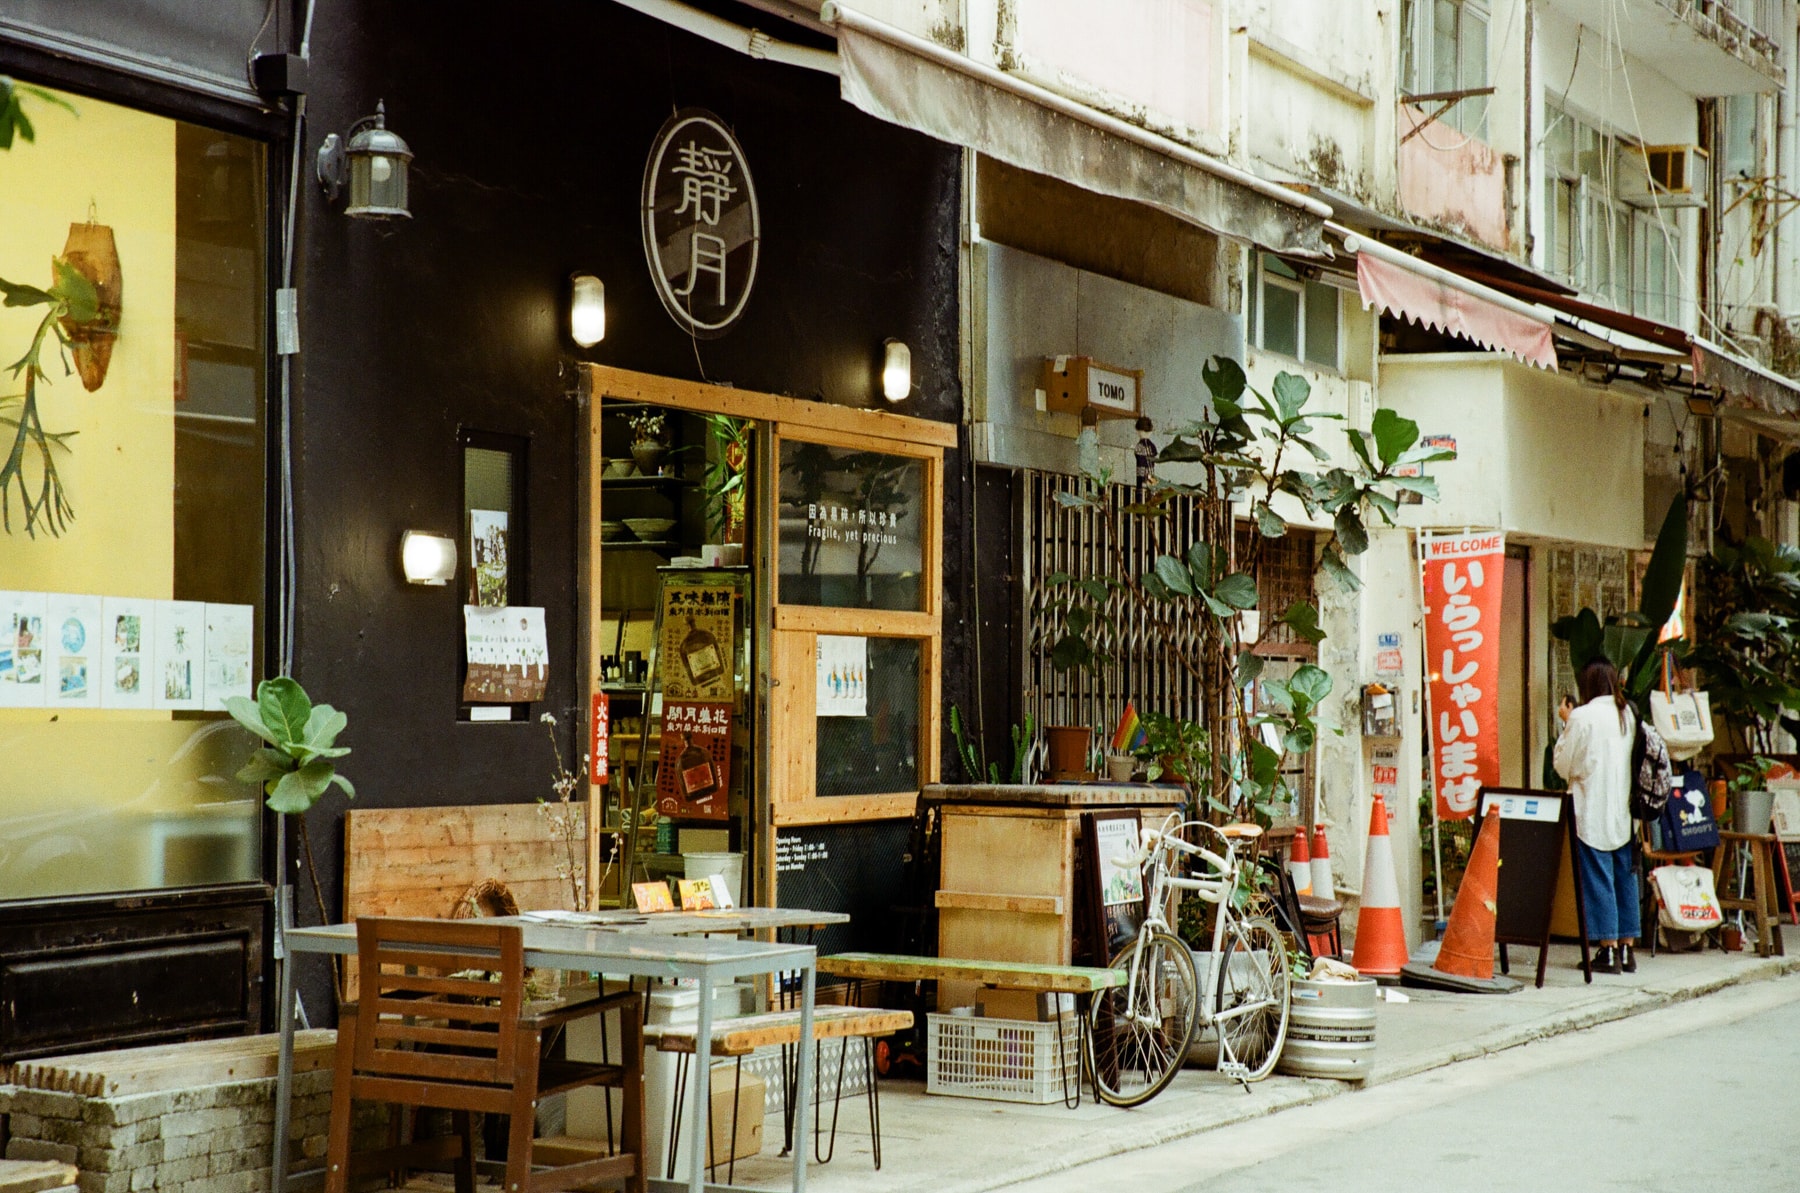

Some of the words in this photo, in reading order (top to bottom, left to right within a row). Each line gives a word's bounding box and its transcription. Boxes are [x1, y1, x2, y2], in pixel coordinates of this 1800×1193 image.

[1098, 382, 1125, 401] TOMO
[808, 525, 841, 542] Fragile,
[845, 529, 858, 543] yet
[863, 531, 897, 545] precious
[1431, 536, 1501, 555] WELCOME
[1440, 560, 1485, 813] いらっしゃいませ
[791, 862, 805, 871] Monday
